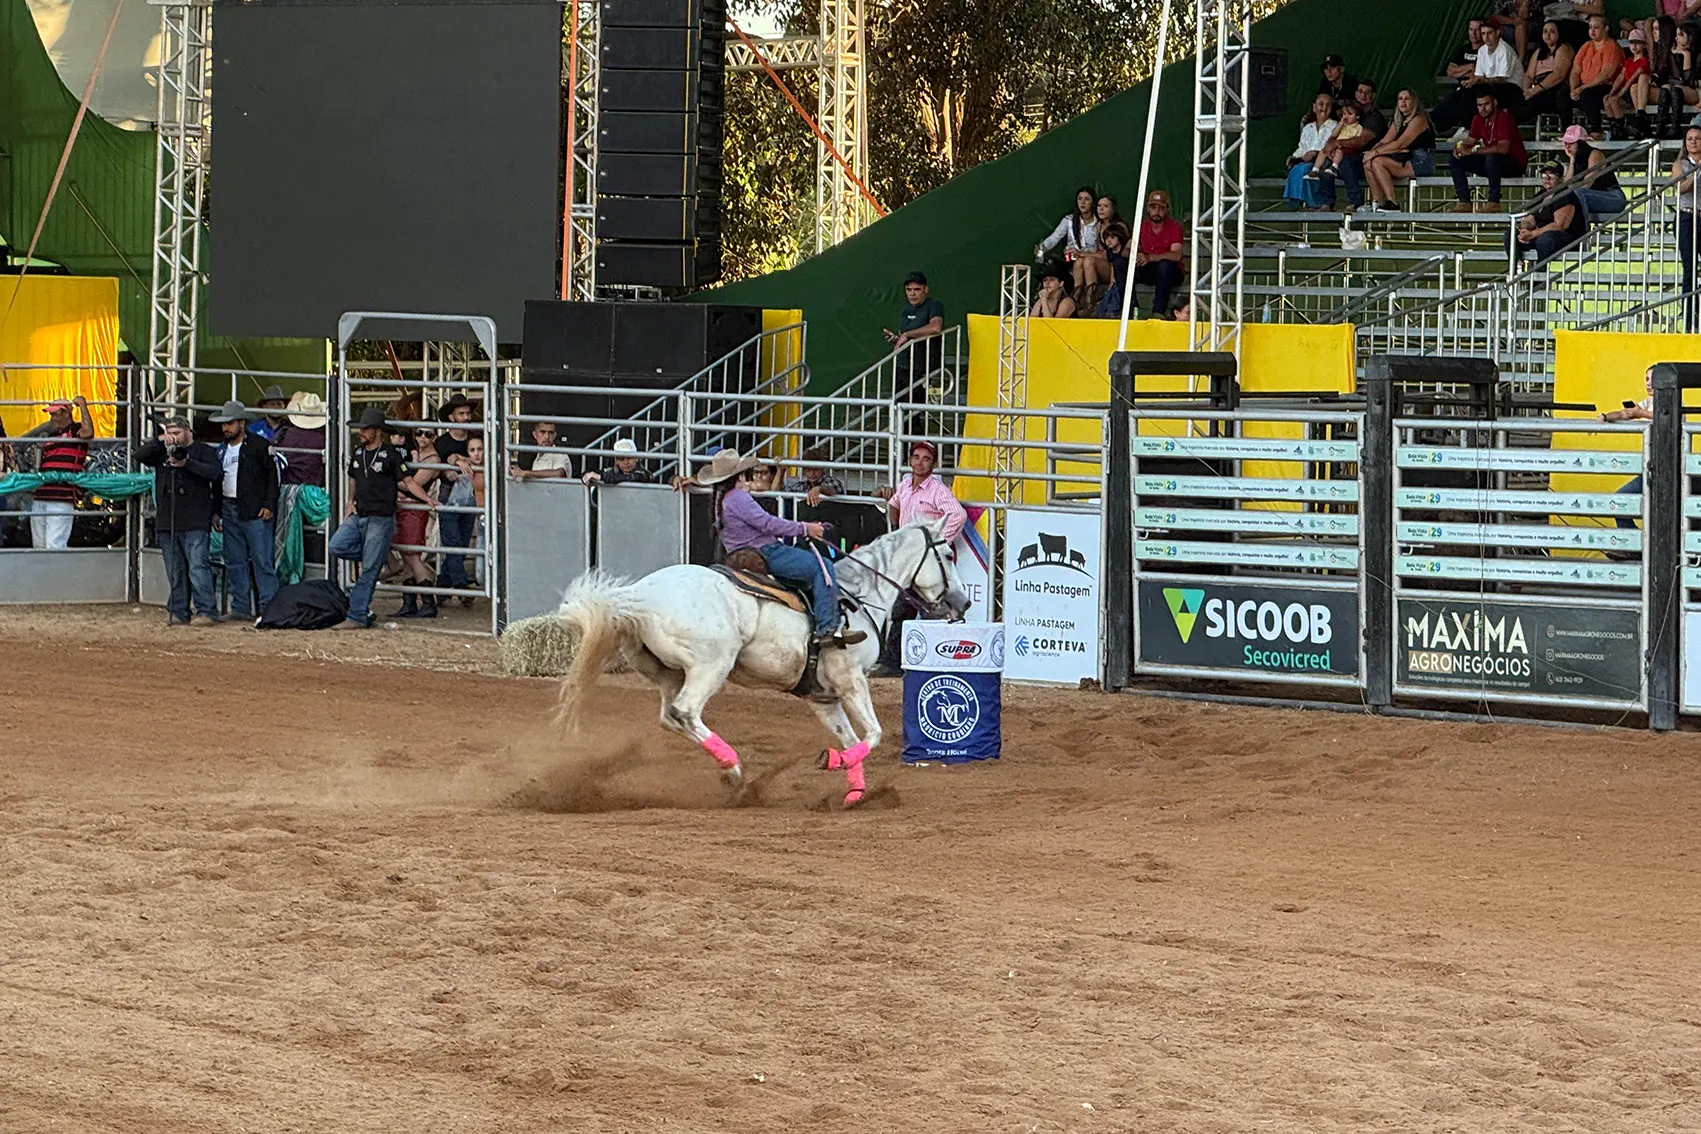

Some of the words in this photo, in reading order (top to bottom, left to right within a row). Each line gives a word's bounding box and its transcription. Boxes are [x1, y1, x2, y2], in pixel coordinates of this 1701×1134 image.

[1015, 580, 1041, 592] Linha
[1044, 582, 1091, 598] Pastagem
[1014, 617, 1036, 626] LINHA
[1036, 618, 1075, 630] PASTAGEM
[1205, 598, 1332, 644] SICOOB
[940, 645, 976, 654] SUPRA
[1033, 638, 1086, 652] CORTEVA
[1244, 645, 1330, 670] Secovicred
[1408, 652, 1530, 676] AGRONEGÓCIOS
